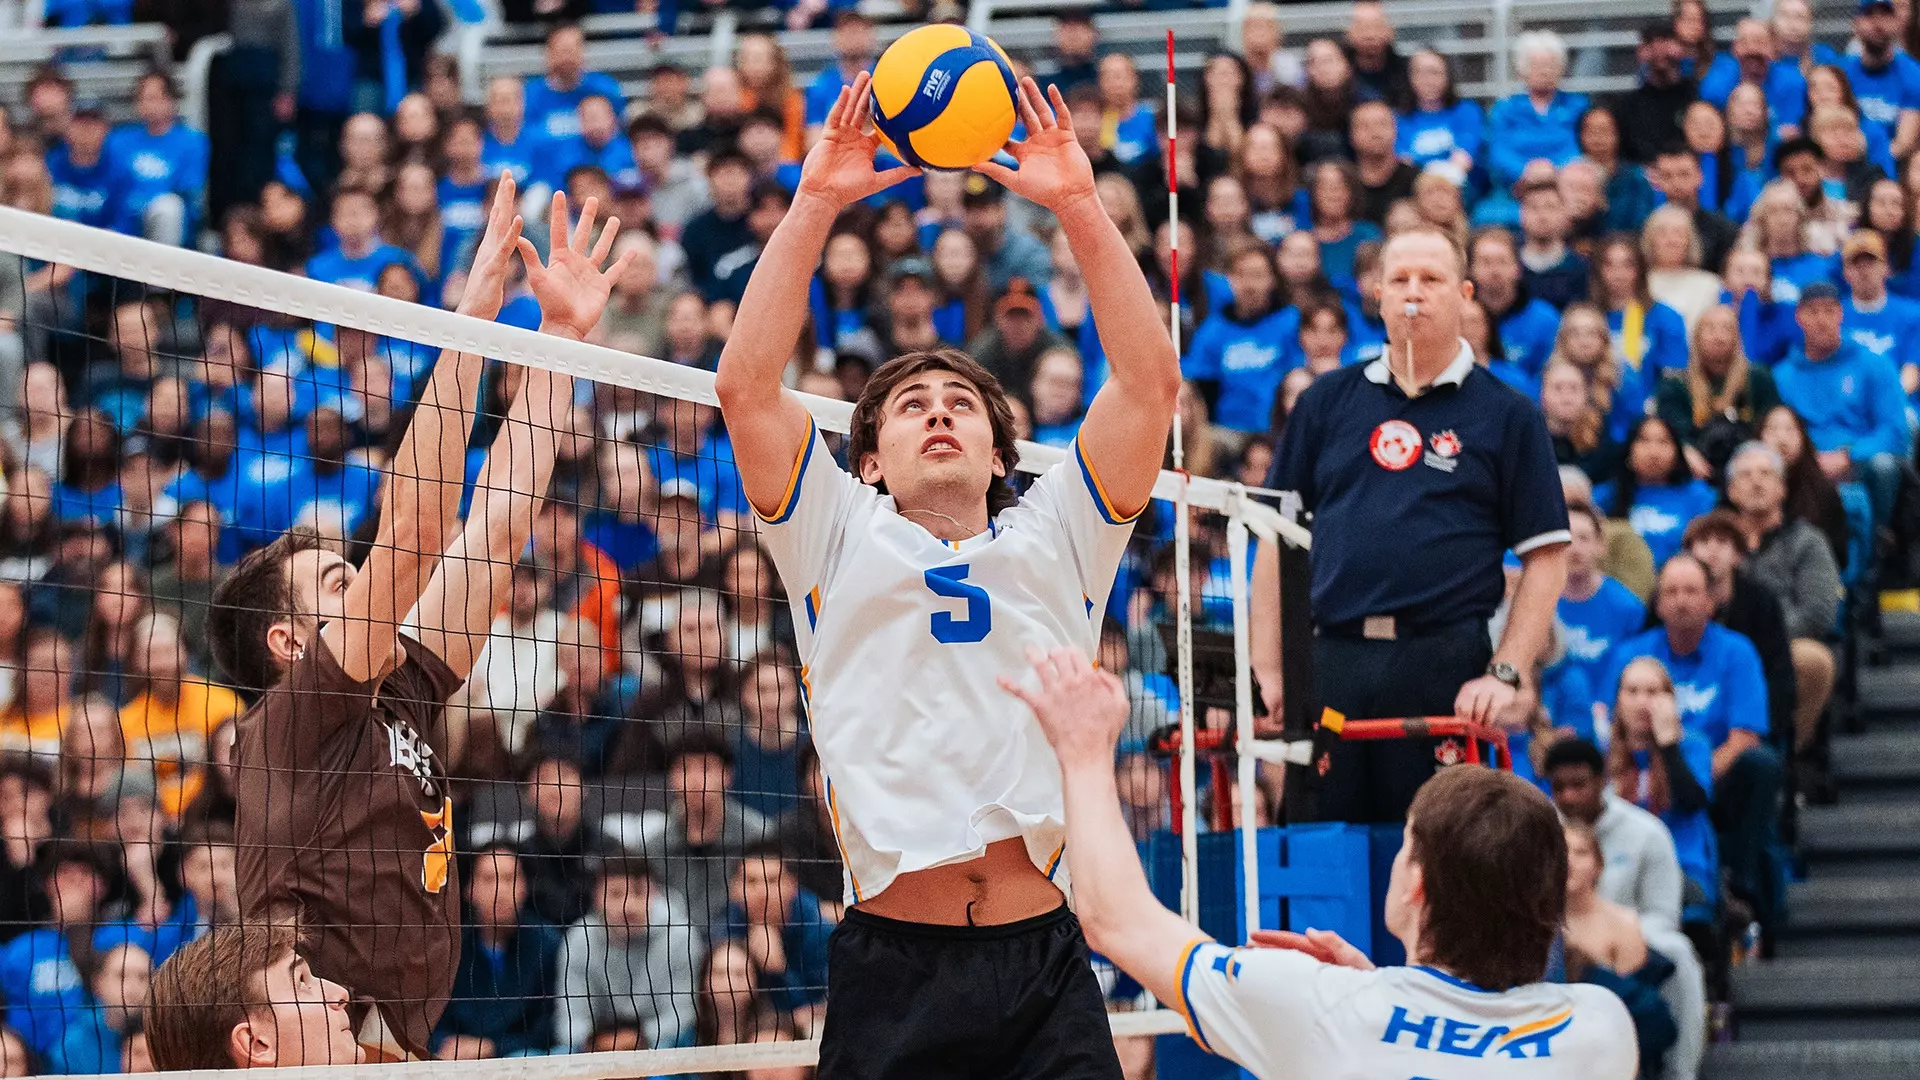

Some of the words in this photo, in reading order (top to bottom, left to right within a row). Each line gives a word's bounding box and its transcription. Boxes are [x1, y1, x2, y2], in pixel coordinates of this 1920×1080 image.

[923, 68, 944, 98] FIVB
[924, 563, 992, 644] 5
[1381, 1004, 1573, 1058] HEAT
